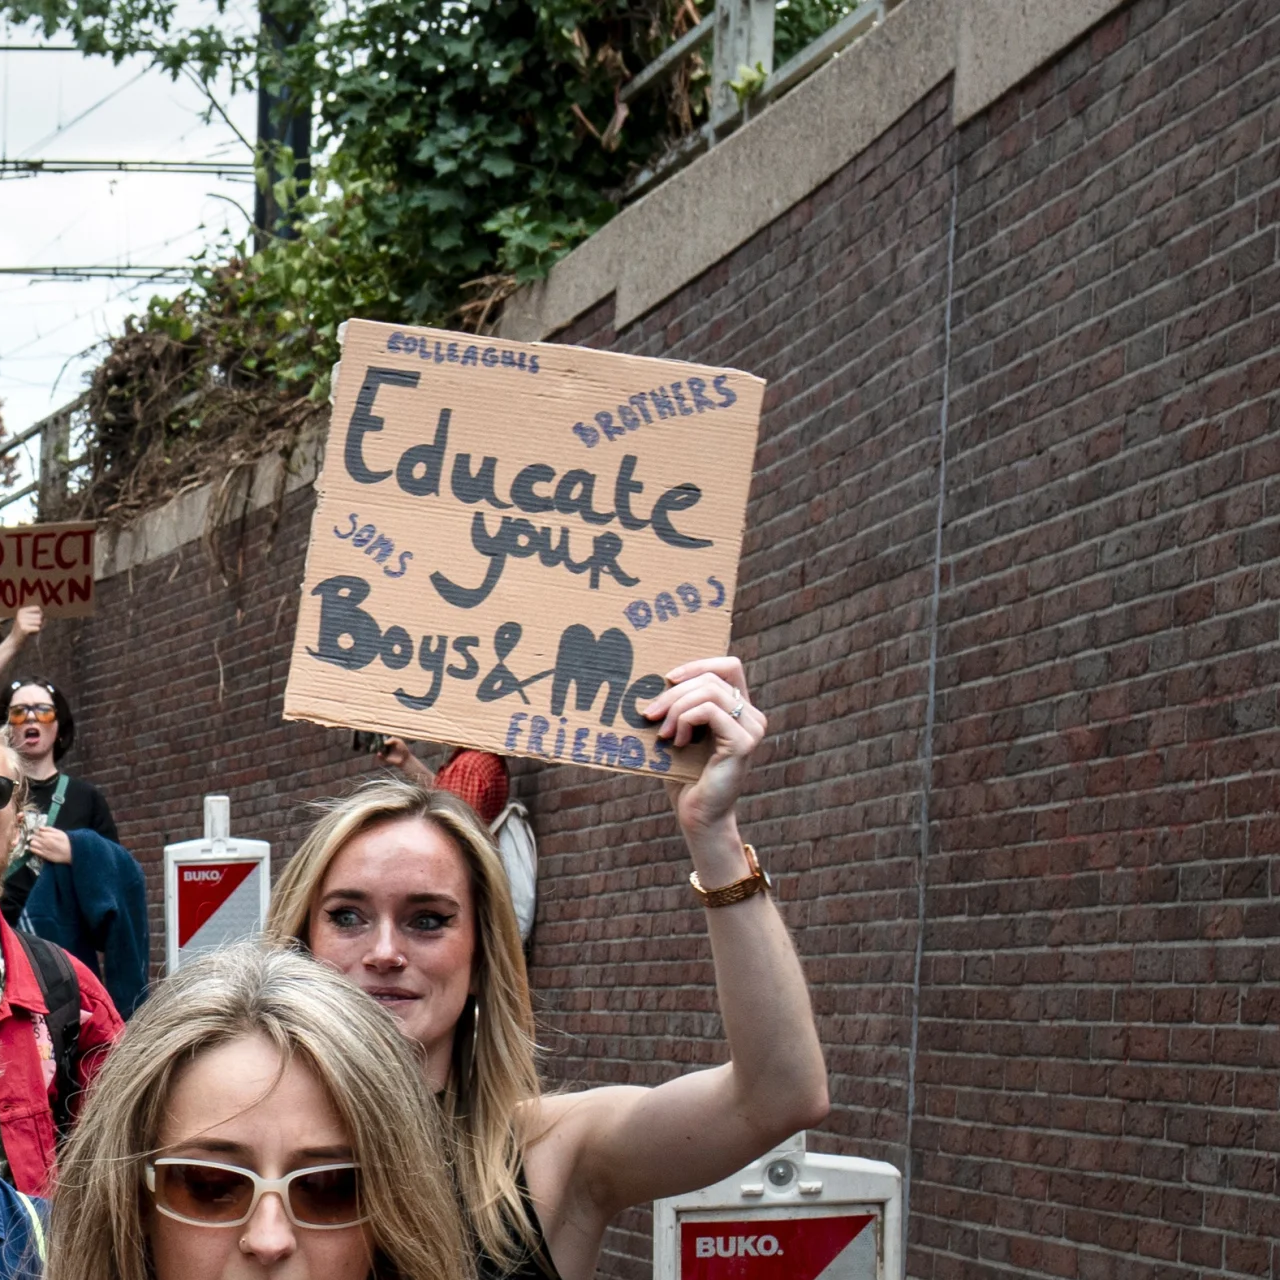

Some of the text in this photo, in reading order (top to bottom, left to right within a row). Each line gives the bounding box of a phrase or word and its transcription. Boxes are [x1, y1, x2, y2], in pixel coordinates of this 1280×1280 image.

[571, 374, 738, 448] BROTHERS
[342, 365, 714, 549] Educate
[622, 575, 726, 632] DADS
[696, 1235, 784, 1258] BUKO.
